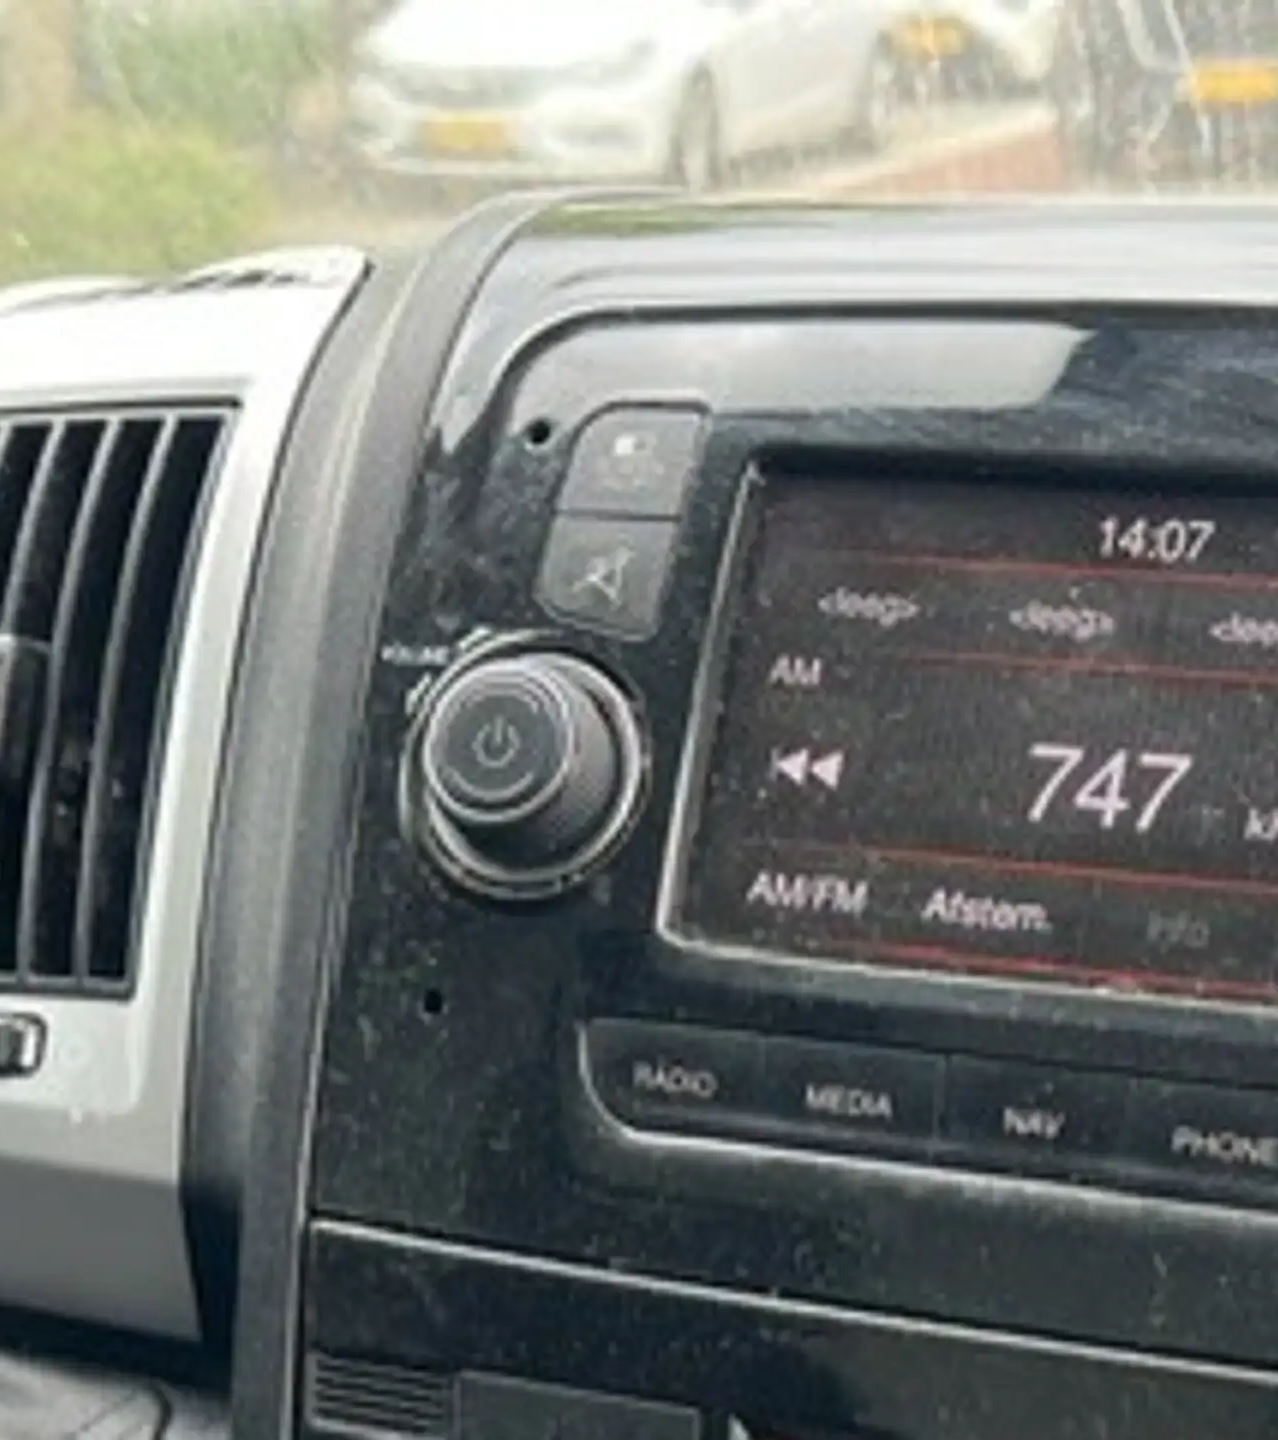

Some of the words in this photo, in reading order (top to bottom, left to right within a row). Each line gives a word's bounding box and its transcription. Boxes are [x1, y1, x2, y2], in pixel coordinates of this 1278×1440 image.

[1101, 517, 1216, 564] 14:07
[770, 655, 823, 688] AM
[1028, 742, 1194, 832] 747
[632, 1064, 717, 1099] RADIO
[804, 1084, 894, 1120] MEDIA
[1003, 1106, 1065, 1139] NAV
